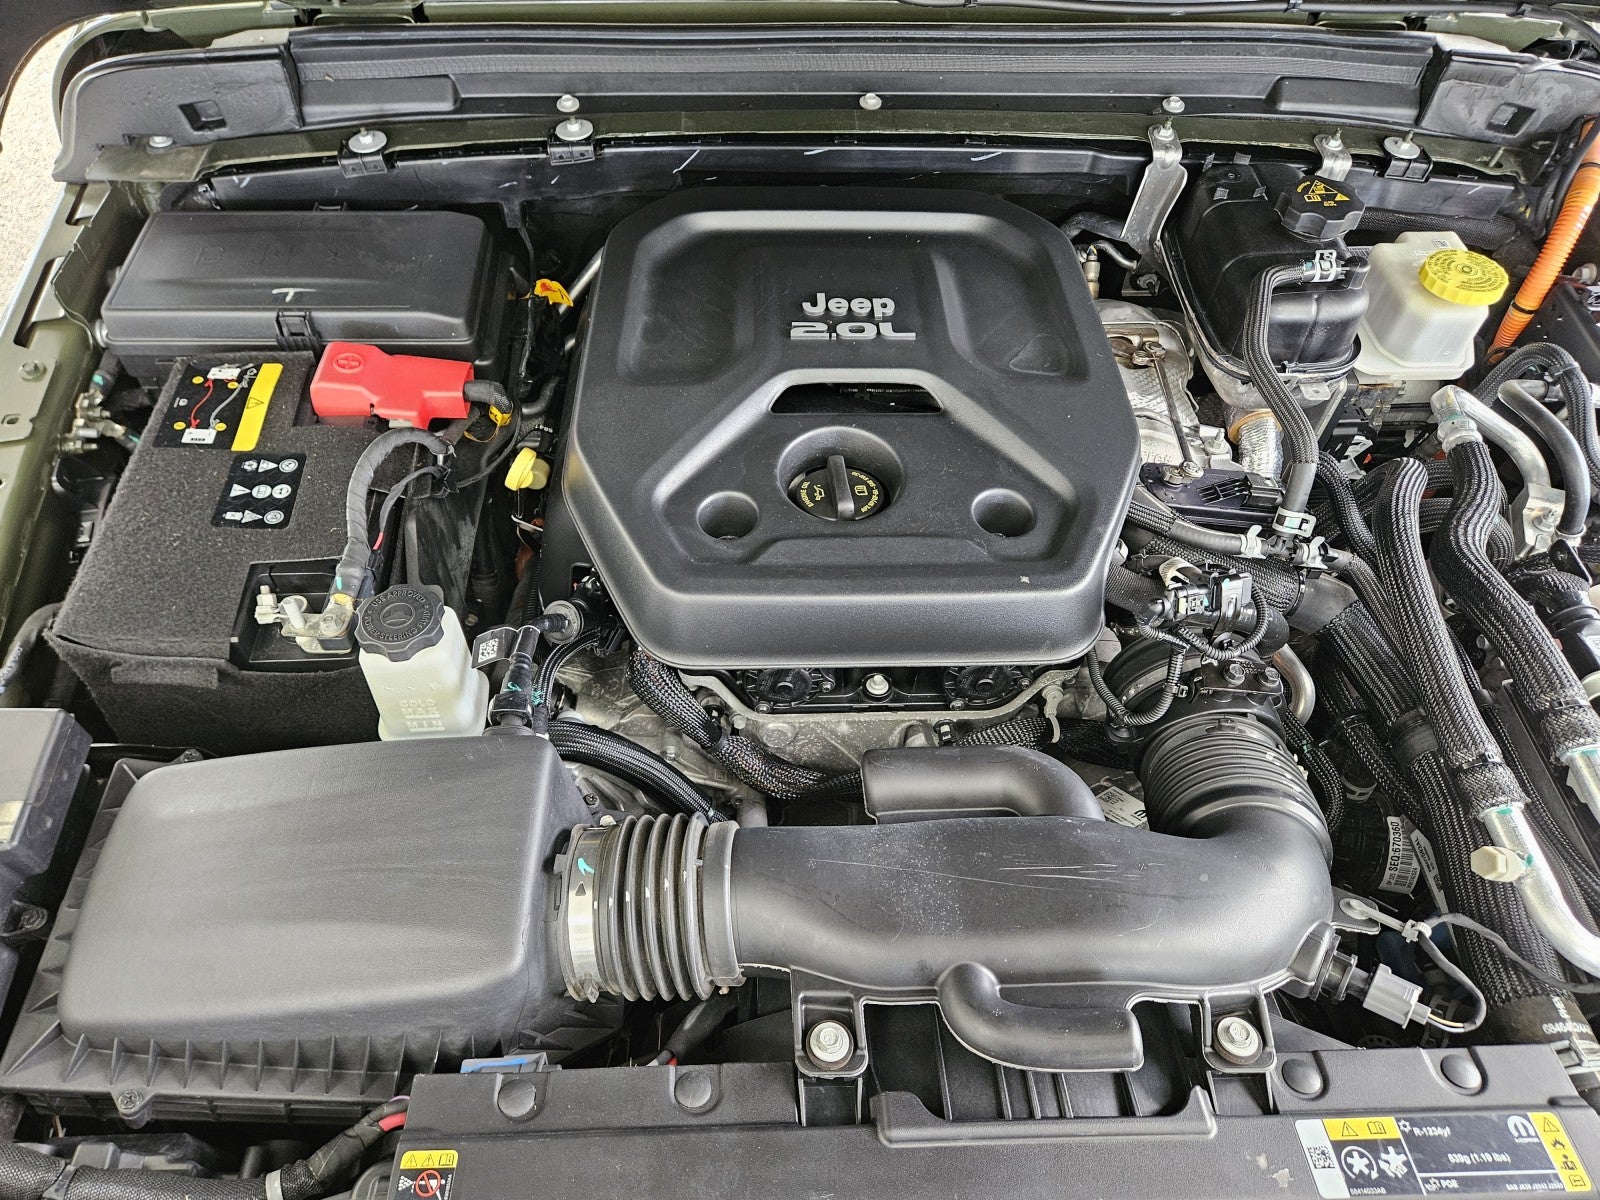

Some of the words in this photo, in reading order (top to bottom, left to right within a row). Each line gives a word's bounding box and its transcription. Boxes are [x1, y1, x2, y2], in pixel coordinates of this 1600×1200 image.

[802, 292, 896, 320] Jeep
[790, 321, 917, 340] 2.0L
[801, 480, 811, 489] OIL
[800, 489, 815, 508] ENGINE
[371, 595, 386, 607] USE
[387, 589, 426, 603] APPROVED
[364, 616, 381, 637] POWER
[379, 627, 418, 641] STEERING
[417, 610, 431, 629] FLUID
[400, 699, 436, 708] COLD
[401, 706, 439, 715] MAX
[406, 720, 442, 729] MIN
[1388, 821, 1402, 872] SEQ:670360
[1413, 1126, 1451, 1138] R-1234yf
